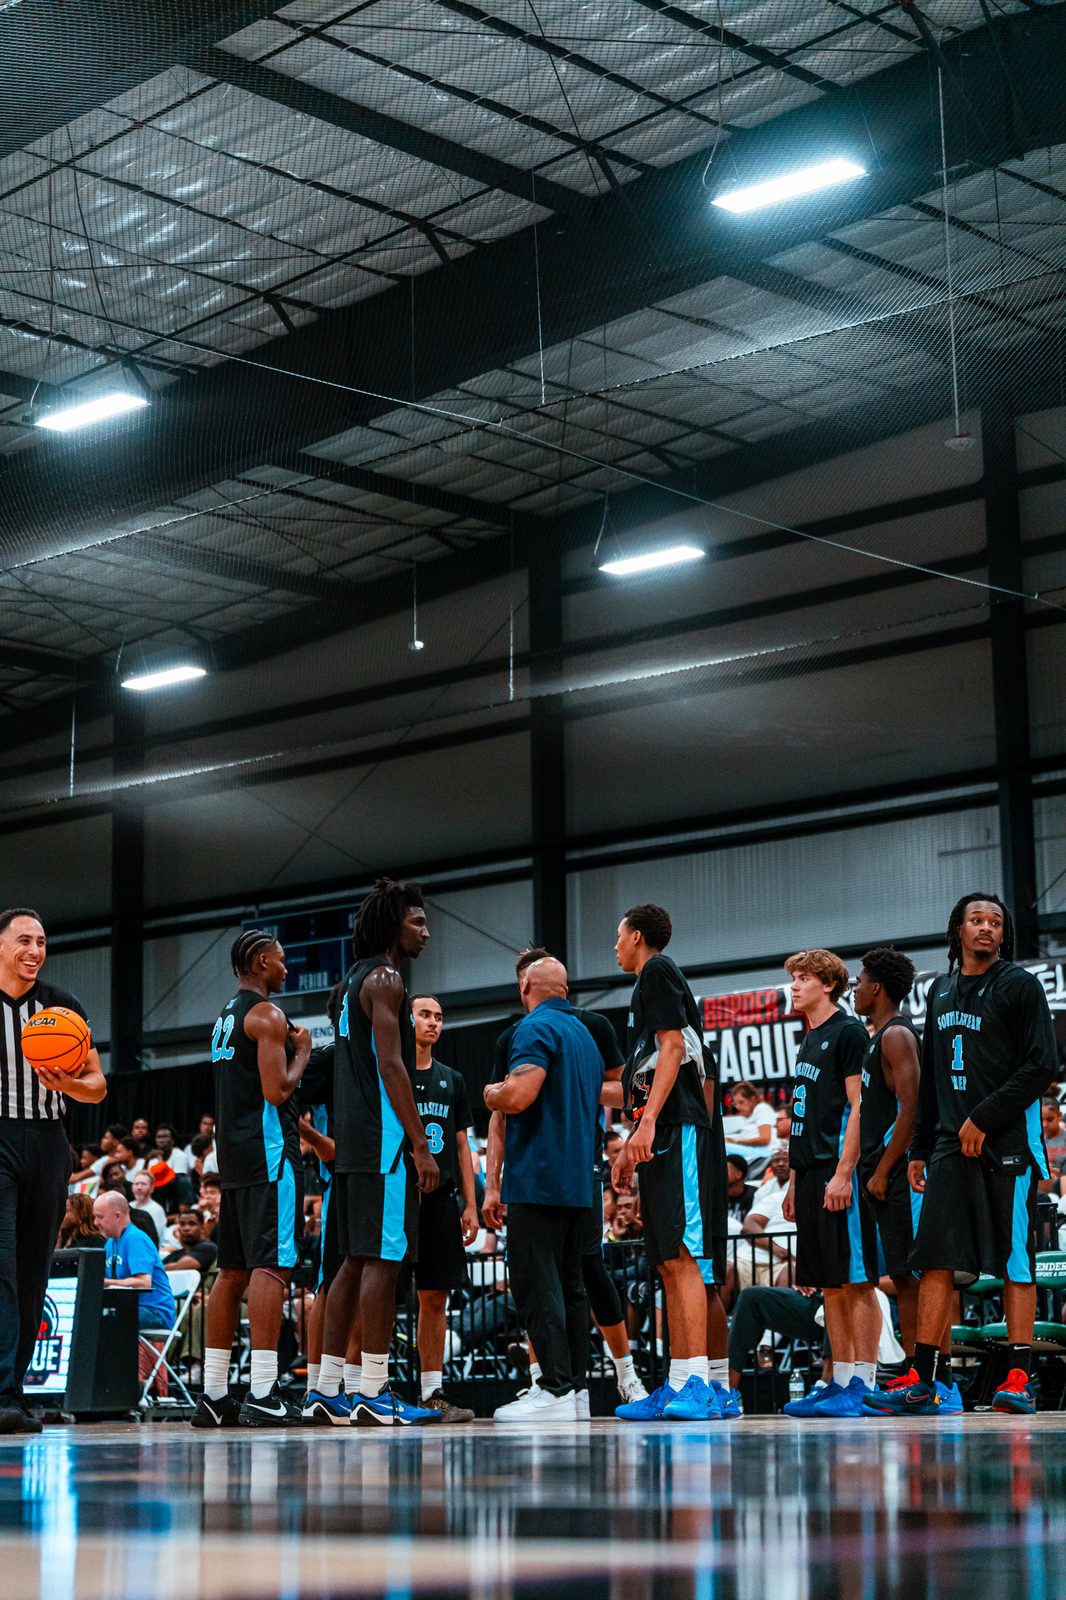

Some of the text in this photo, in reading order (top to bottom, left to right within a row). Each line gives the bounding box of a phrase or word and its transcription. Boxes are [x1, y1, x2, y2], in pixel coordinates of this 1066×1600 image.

[28, 1017, 57, 1028] NCAA
[704, 989, 778, 1030] BORDER
[211, 1014, 235, 1063] 22
[952, 1034, 963, 1070] 1
